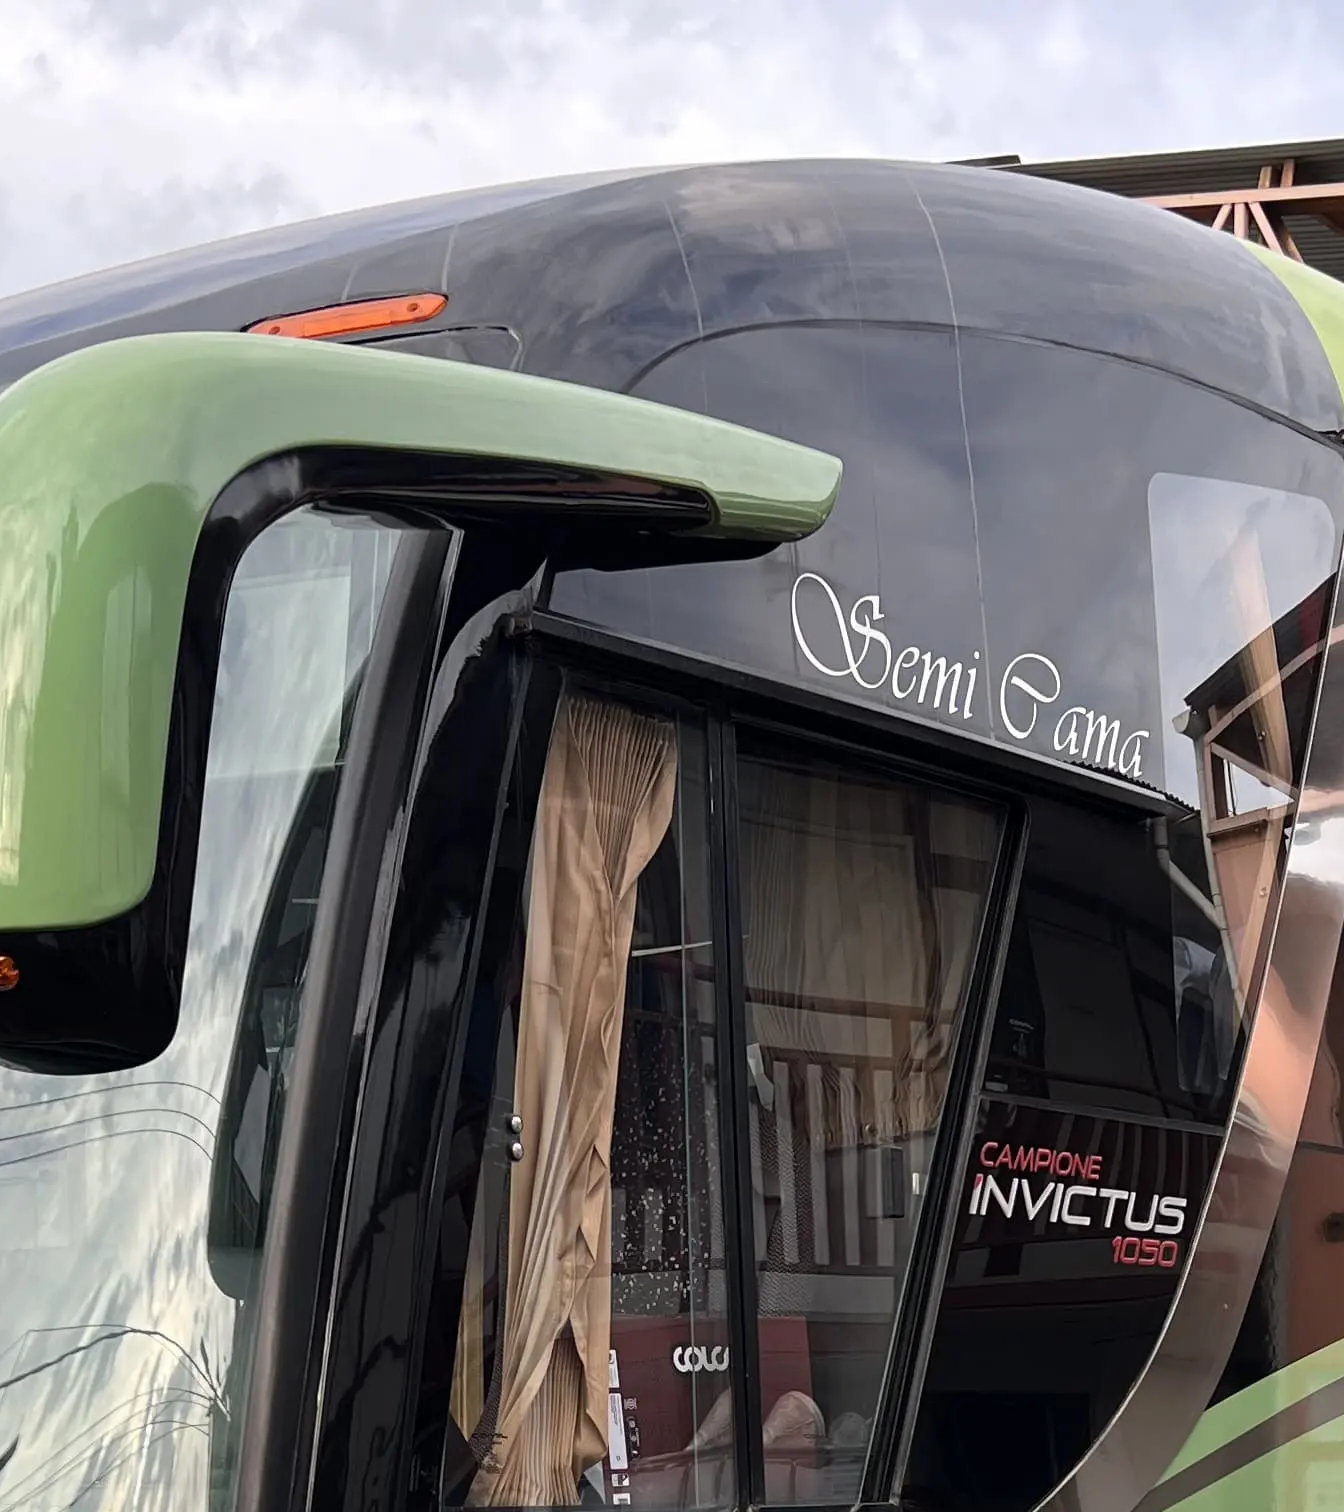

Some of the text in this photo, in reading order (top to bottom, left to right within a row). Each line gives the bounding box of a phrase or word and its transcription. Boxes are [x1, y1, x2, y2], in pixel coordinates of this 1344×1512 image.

[791, 572, 1150, 777] Semi Cama
[979, 1141, 1104, 1181] CAMPIONE
[968, 1172, 1188, 1235] INVICTUS
[1111, 1235, 1179, 1268] 1050
